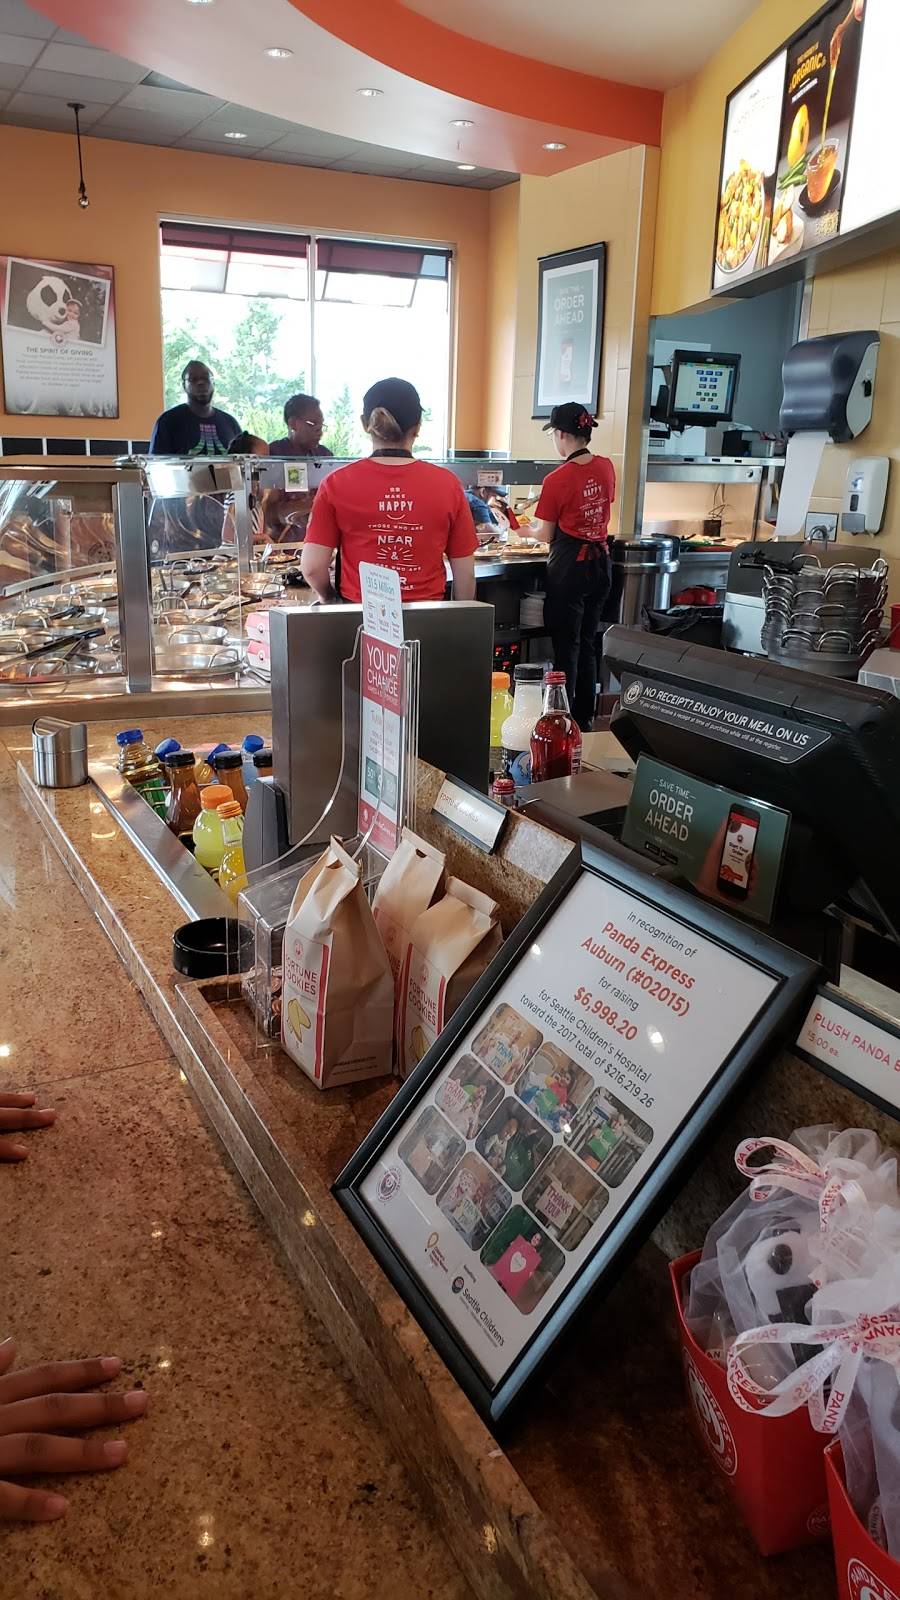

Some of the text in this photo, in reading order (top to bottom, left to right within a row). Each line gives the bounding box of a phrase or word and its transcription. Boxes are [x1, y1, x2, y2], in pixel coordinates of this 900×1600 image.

[792, 52, 823, 89] ORGANIC
[553, 310, 584, 326] AHEAD
[554, 294, 584, 312] ORDER
[378, 501, 413, 512] HAPPY
[377, 536, 413, 547] NEAR
[391, 552, 398, 560] &
[366, 643, 397, 676] YOUR
[367, 668, 398, 697] CHANGE
[643, 686, 656, 698] NO
[656, 690, 694, 709] RECEIPT?
[692, 702, 723, 718] ENJOY
[722, 711, 748, 726] YOUR
[748, 718, 774, 736] MEAL
[776, 727, 793, 740] ON
[710, 724, 730, 734] purchase
[650, 789, 693, 822] ORDER
[659, 779, 690, 799] SAVE TIME
[645, 809, 688, 841] AHEAD
[626, 912, 698, 958] In recognition of
[602, 922, 696, 990] Panda Express
[580, 937, 690, 1017] Auburn (#02015)
[598, 976, 639, 1012] for raising
[409, 991, 436, 1026] COOKIES
[410, 977, 436, 1013] FORTUNE
[574, 986, 638, 1040] $6,998.20
[520, 994, 654, 1108] toward the 2017 total of $216,219.26
[538, 989, 652, 1084] for Seattle Children's Hospital
[814, 1013, 850, 1040] PLUSH
[852, 1036, 890, 1065] PANDA
[547, 1185, 572, 1214] THANK
[463, 1288, 480, 1313] Seattle
[480, 1311, 504, 1346] Children's
[822, 1390, 845, 1432] PANDA
